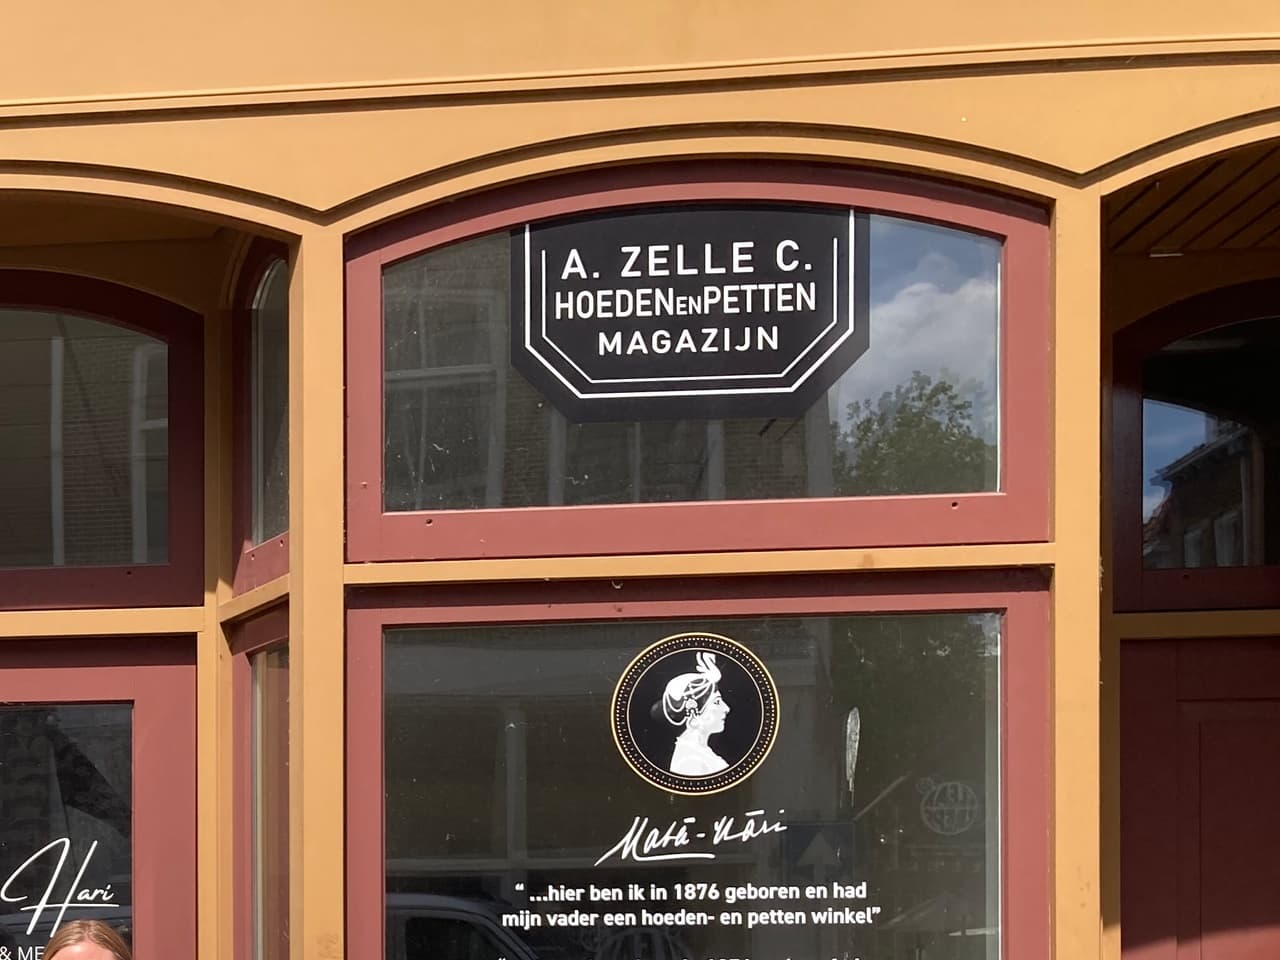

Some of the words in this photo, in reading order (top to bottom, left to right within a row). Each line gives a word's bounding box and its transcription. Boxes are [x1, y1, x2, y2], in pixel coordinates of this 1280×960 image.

[561, 249, 600, 279] A.
[621, 241, 754, 277] ZELLE
[776, 240, 812, 271] C.
[599, 326, 778, 355] MAGAZIJN
[590, 885, 623, 901] ben
[628, 884, 645, 901] ik
[650, 884, 668, 900] in
[674, 884, 720, 900] 1876
[725, 883, 800, 903] geboren
[805, 886, 828, 899] en
[833, 882, 867, 898] had
[502, 910, 542, 930] mijn
[546, 910, 599, 926] vader
[604, 913, 636, 926] een
[642, 909, 715, 925] hoeden-
[720, 912, 743, 925] en
[748, 909, 806, 928] petten
